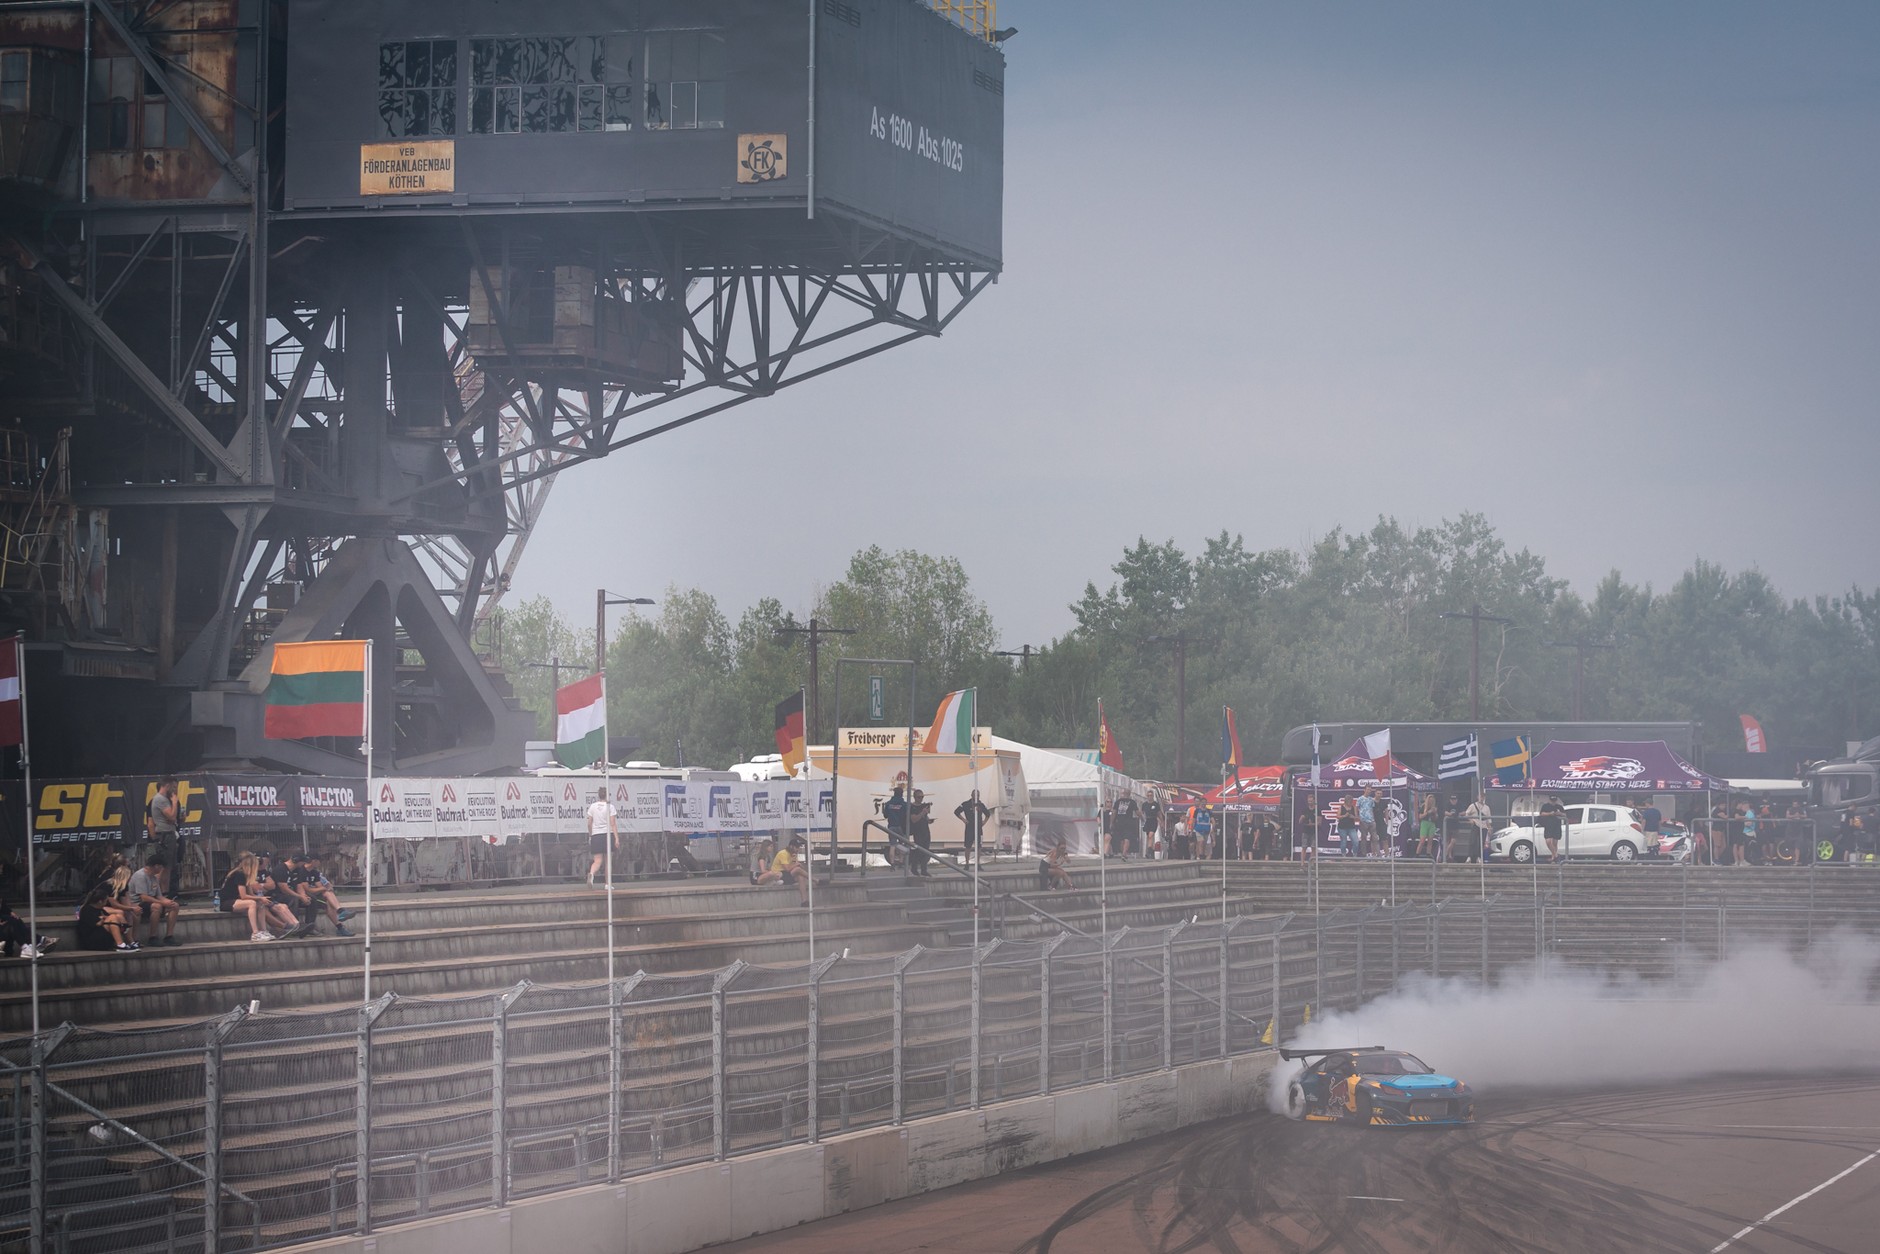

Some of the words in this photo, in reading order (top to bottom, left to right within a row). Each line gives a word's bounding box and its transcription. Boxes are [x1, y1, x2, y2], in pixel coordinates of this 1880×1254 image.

[870, 106, 886, 141] As
[889, 113, 913, 151] 1600
[399, 147, 415, 156] VEB
[363, 158, 451, 174] FÖRDERANLAGENBAU
[753, 151, 770, 169] FK
[389, 173, 425, 189] KÖTHEN
[847, 731, 896, 747] Freiberger
[1595, 780, 1627, 789] STARTS
[1628, 780, 1652, 789] HERE
